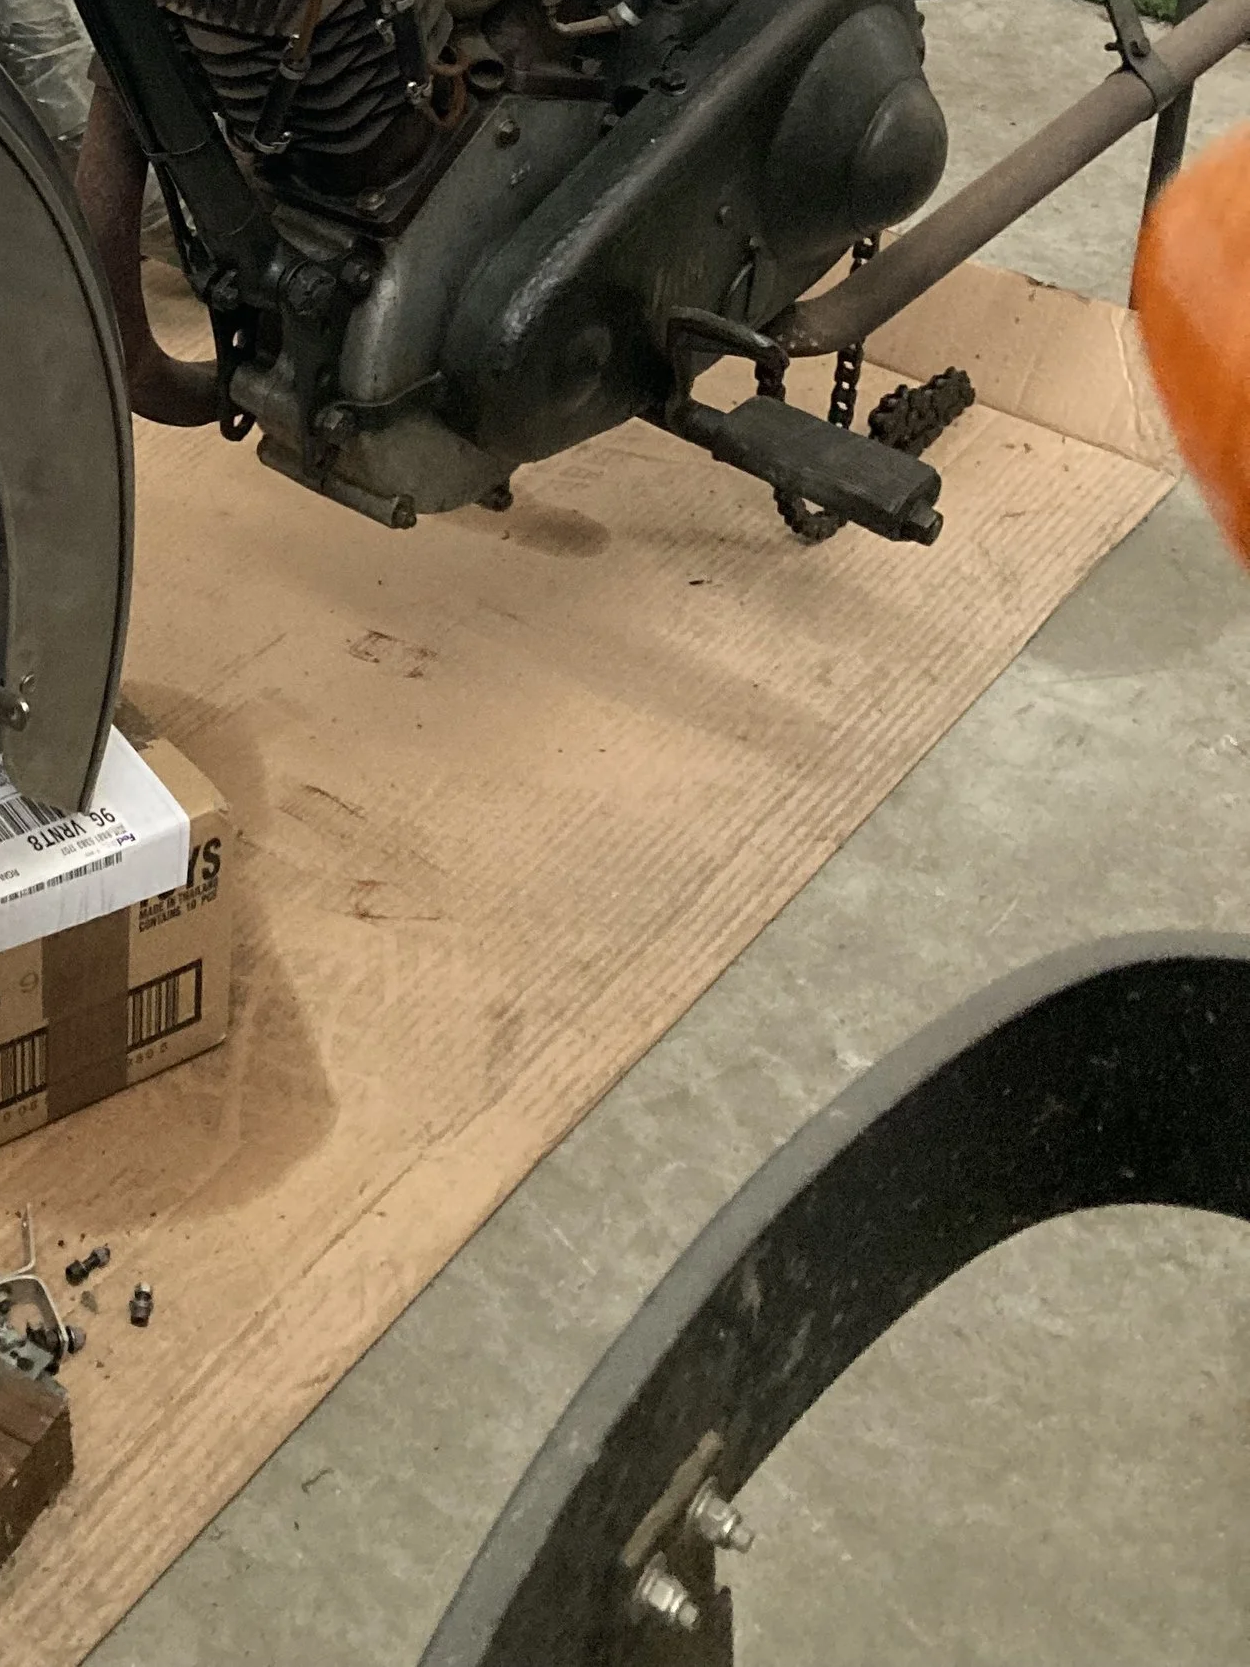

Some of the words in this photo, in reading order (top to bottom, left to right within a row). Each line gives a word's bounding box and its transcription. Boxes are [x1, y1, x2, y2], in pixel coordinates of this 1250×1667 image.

[27, 820, 87, 852] VRNT8
[139, 900, 164, 919] MADE
[139, 906, 182, 932] CONTAINS
